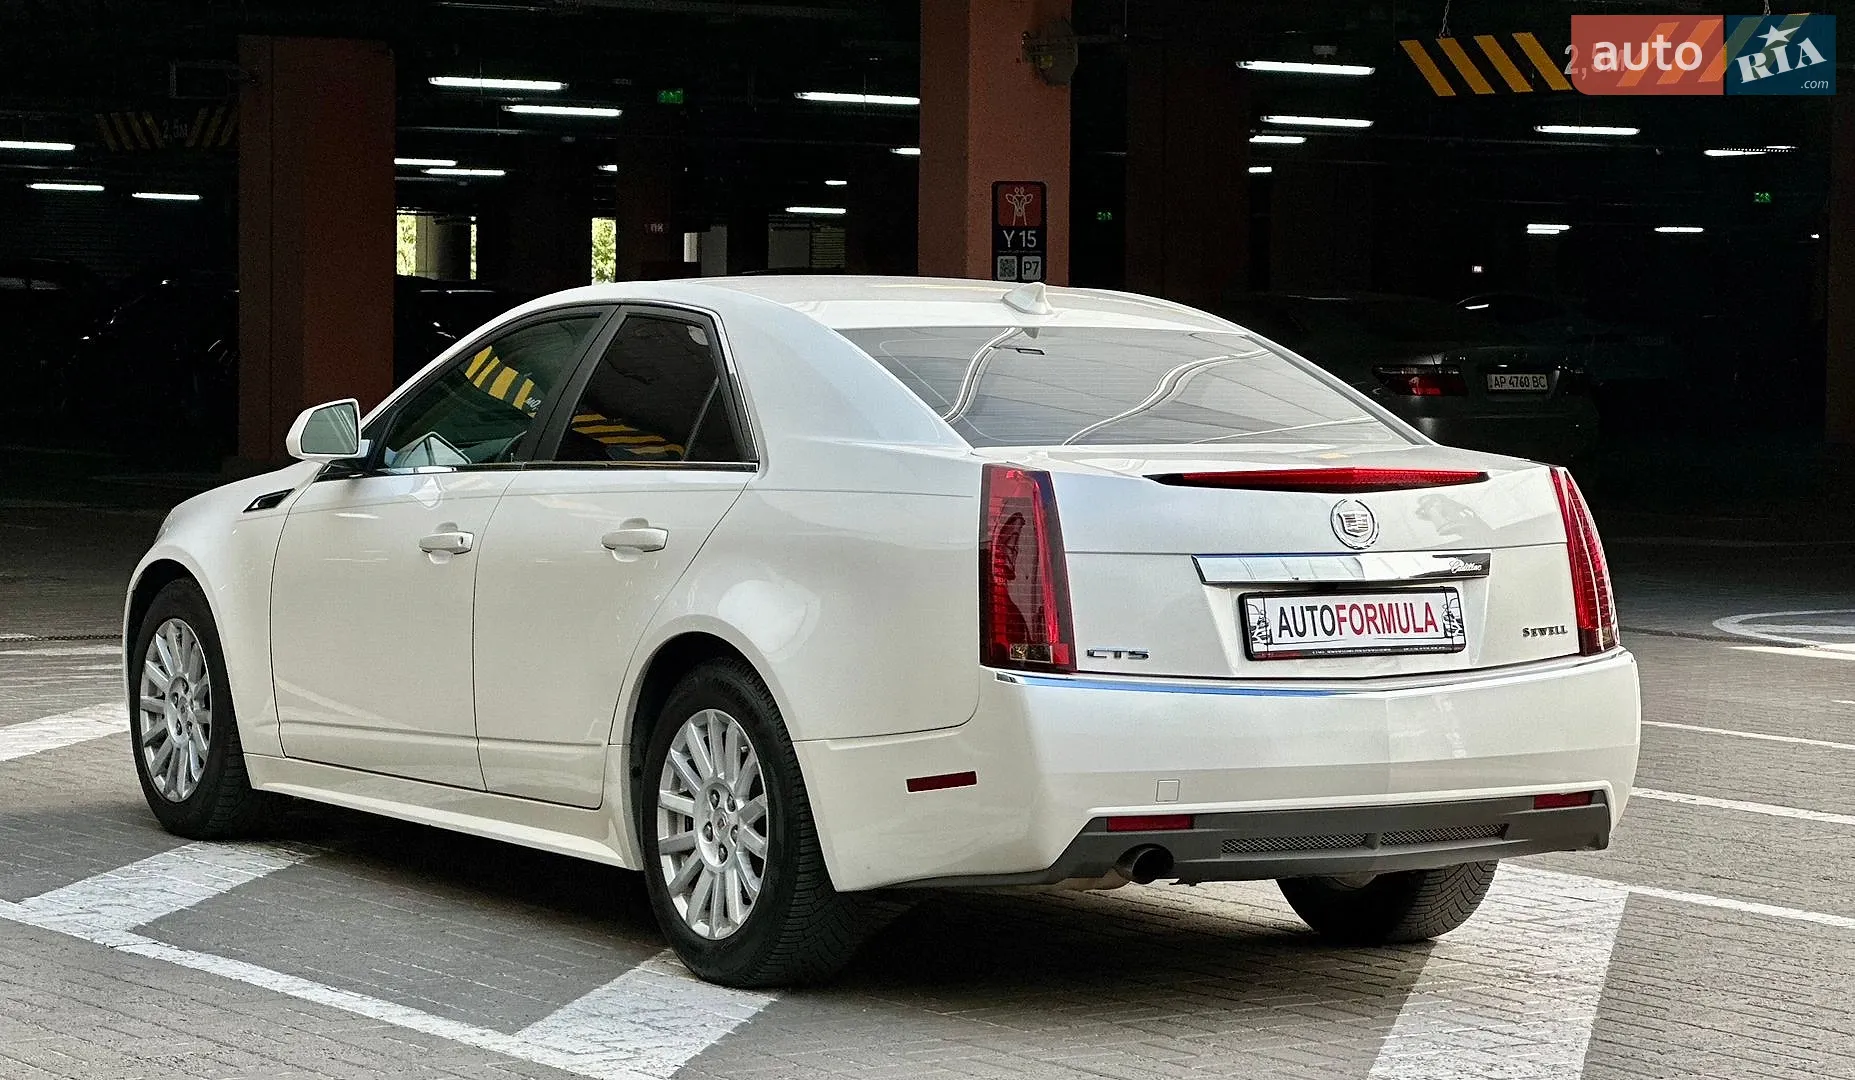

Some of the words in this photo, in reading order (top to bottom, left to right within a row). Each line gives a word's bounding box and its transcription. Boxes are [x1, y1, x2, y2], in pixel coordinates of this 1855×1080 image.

[1003, 230, 1015, 248] Y
[1019, 230, 1037, 248] 15
[1023, 261, 1040, 276] P7
[1494, 376, 1507, 388] AP
[1532, 376, 1546, 388] BC
[1278, 602, 1439, 638] AUTOFORMULA
[1086, 647, 1149, 660] CTS
